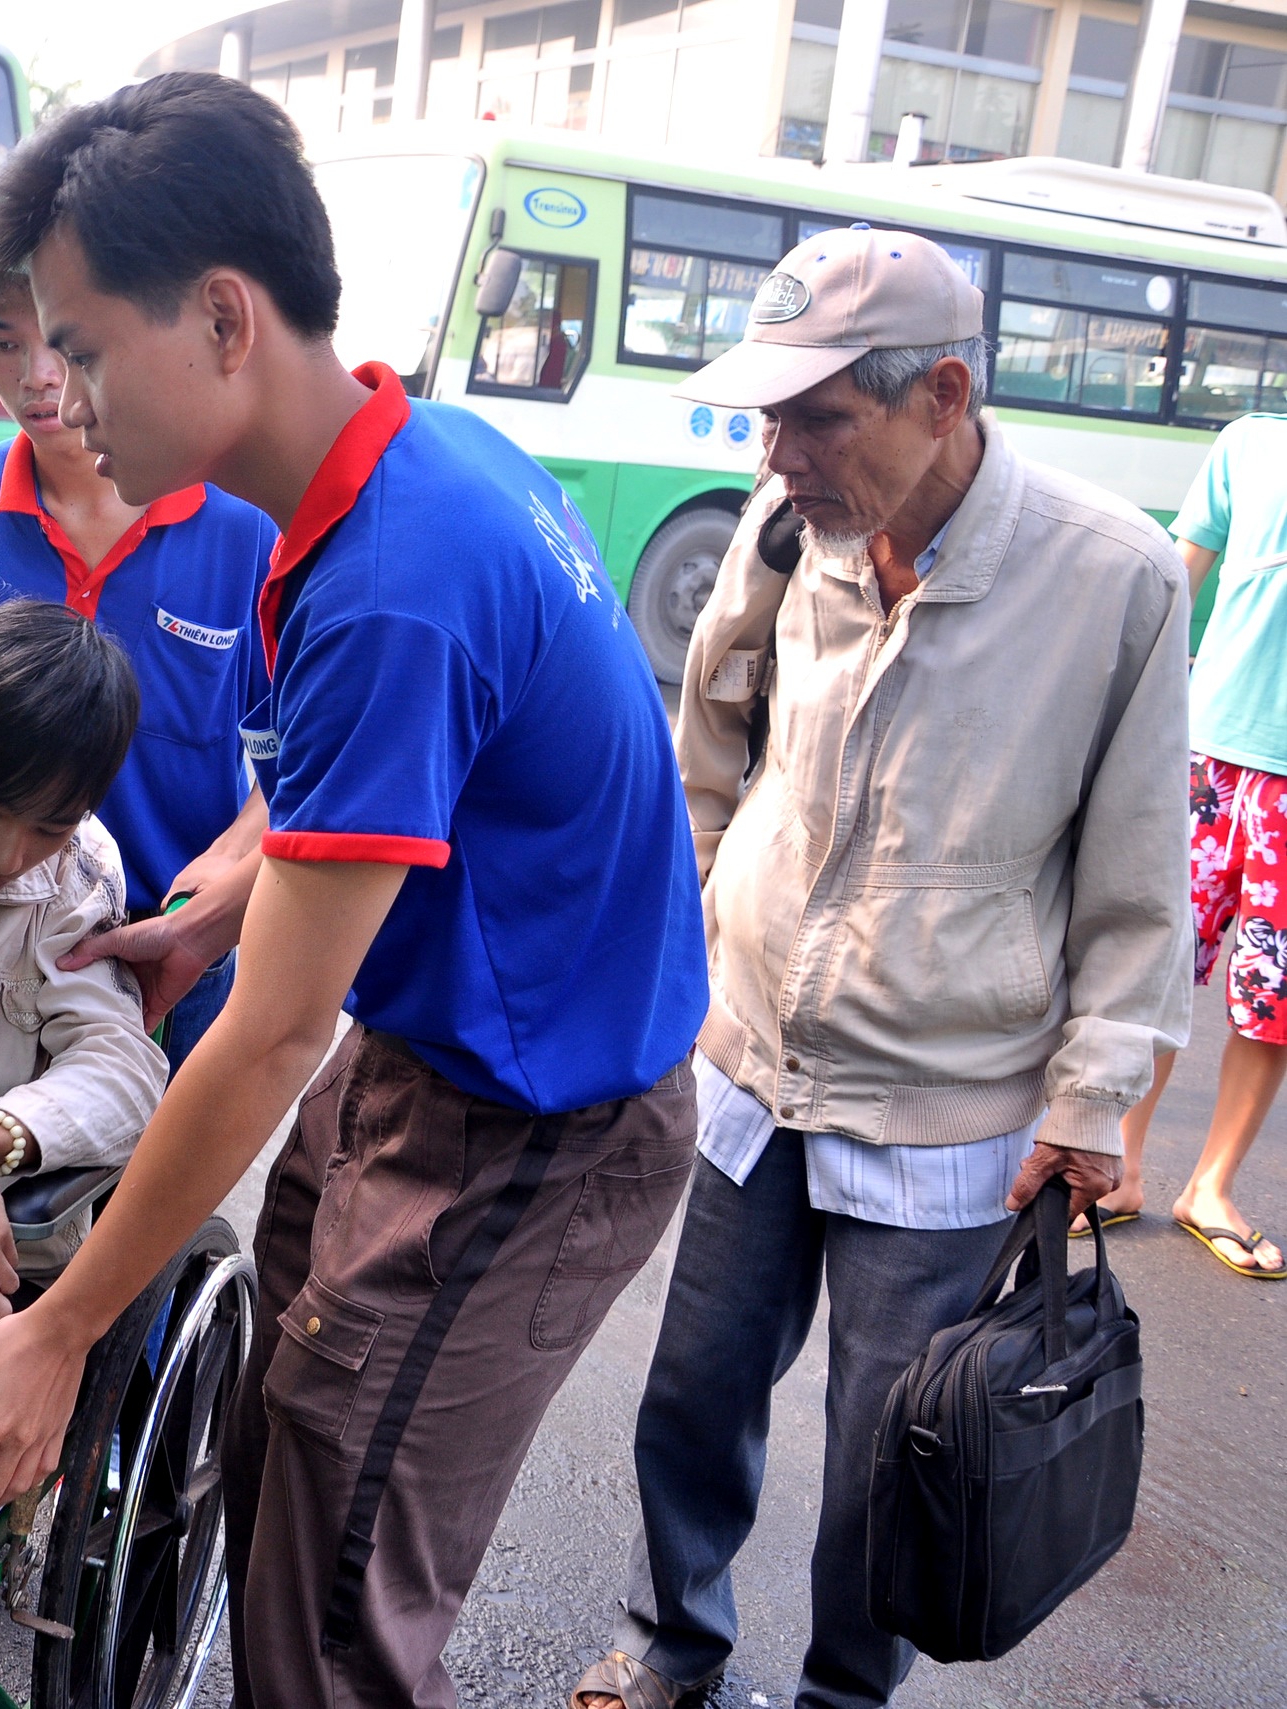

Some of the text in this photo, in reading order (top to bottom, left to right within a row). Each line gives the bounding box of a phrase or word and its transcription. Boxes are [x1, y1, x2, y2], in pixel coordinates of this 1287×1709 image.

[179, 625, 209, 642] THIÊN
[209, 634, 235, 646] LONG
[248, 737, 278, 755] LONG
